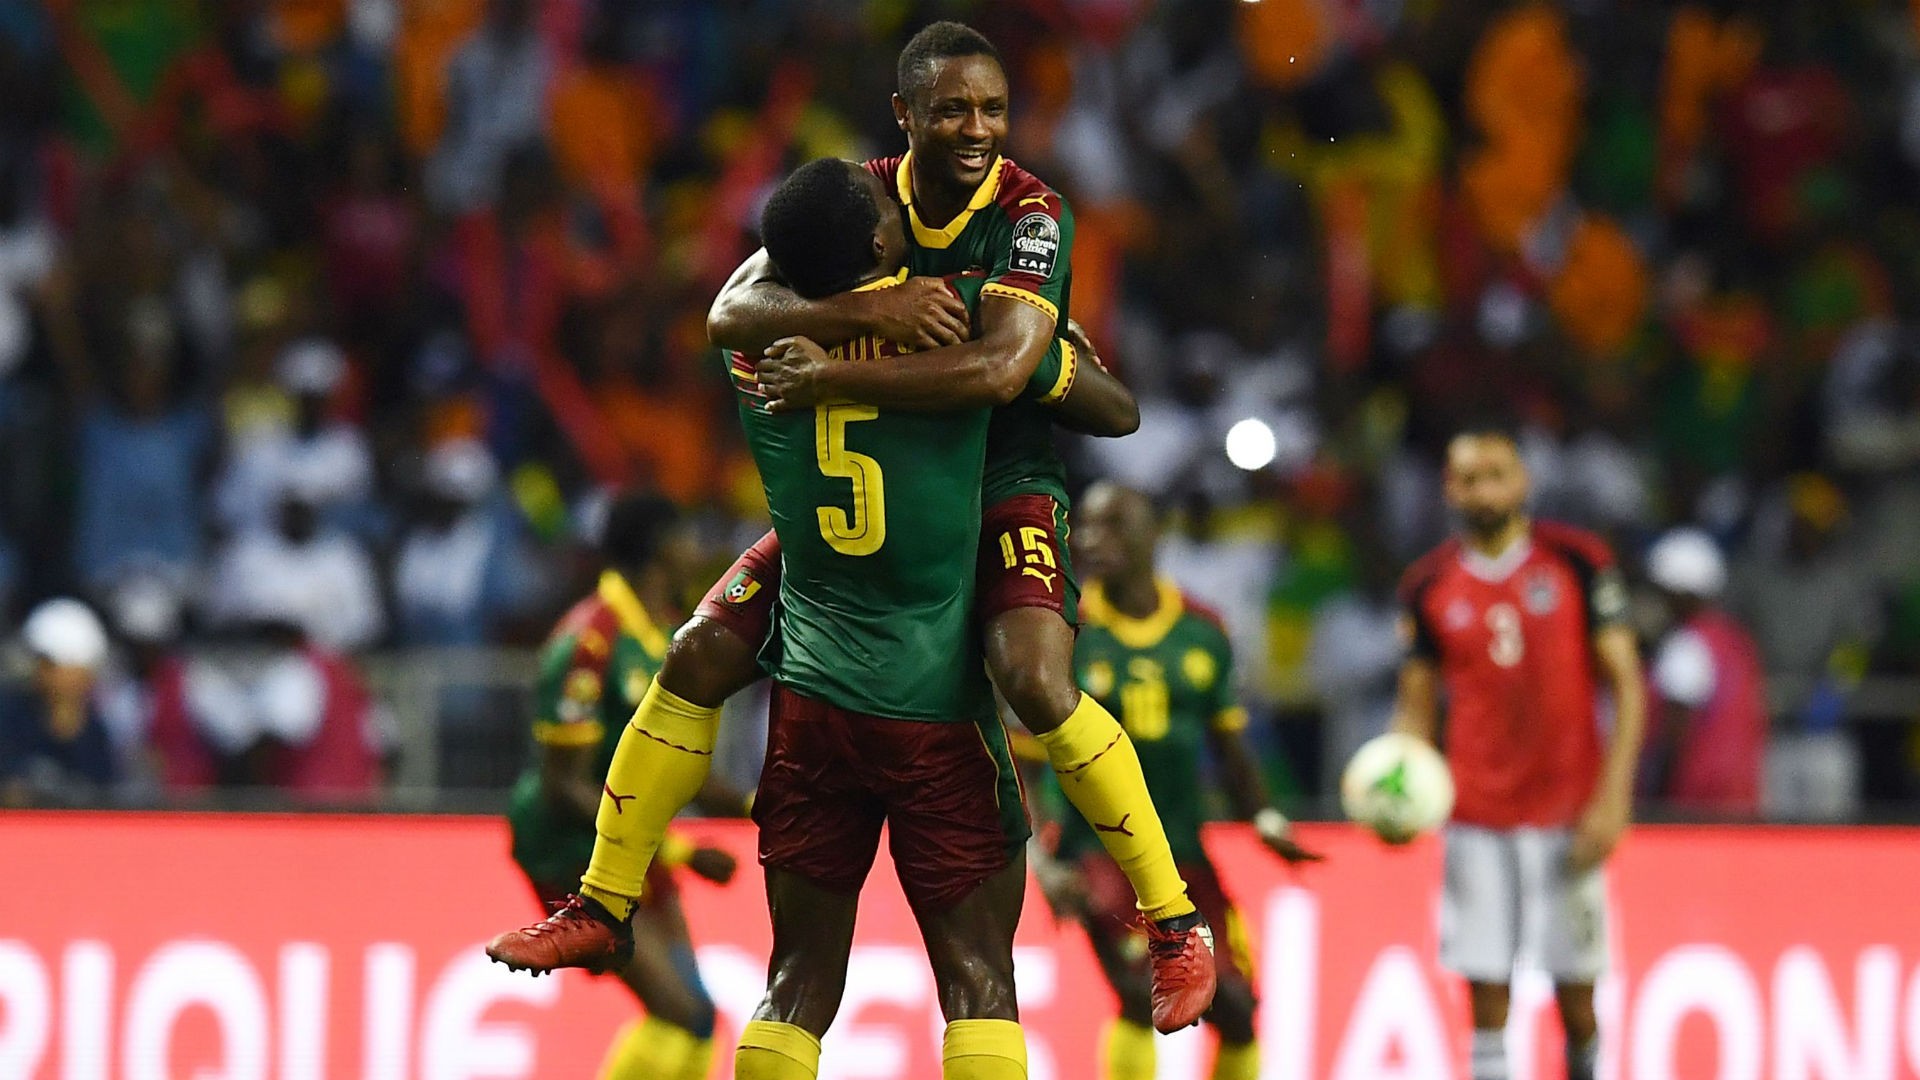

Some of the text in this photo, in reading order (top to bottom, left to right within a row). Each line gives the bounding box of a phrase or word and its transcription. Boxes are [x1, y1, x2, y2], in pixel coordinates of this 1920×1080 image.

[1018, 258, 1047, 270] CAF
[816, 403, 885, 556] 5
[999, 526, 1056, 569] 15
[1484, 602, 1525, 669] 3
